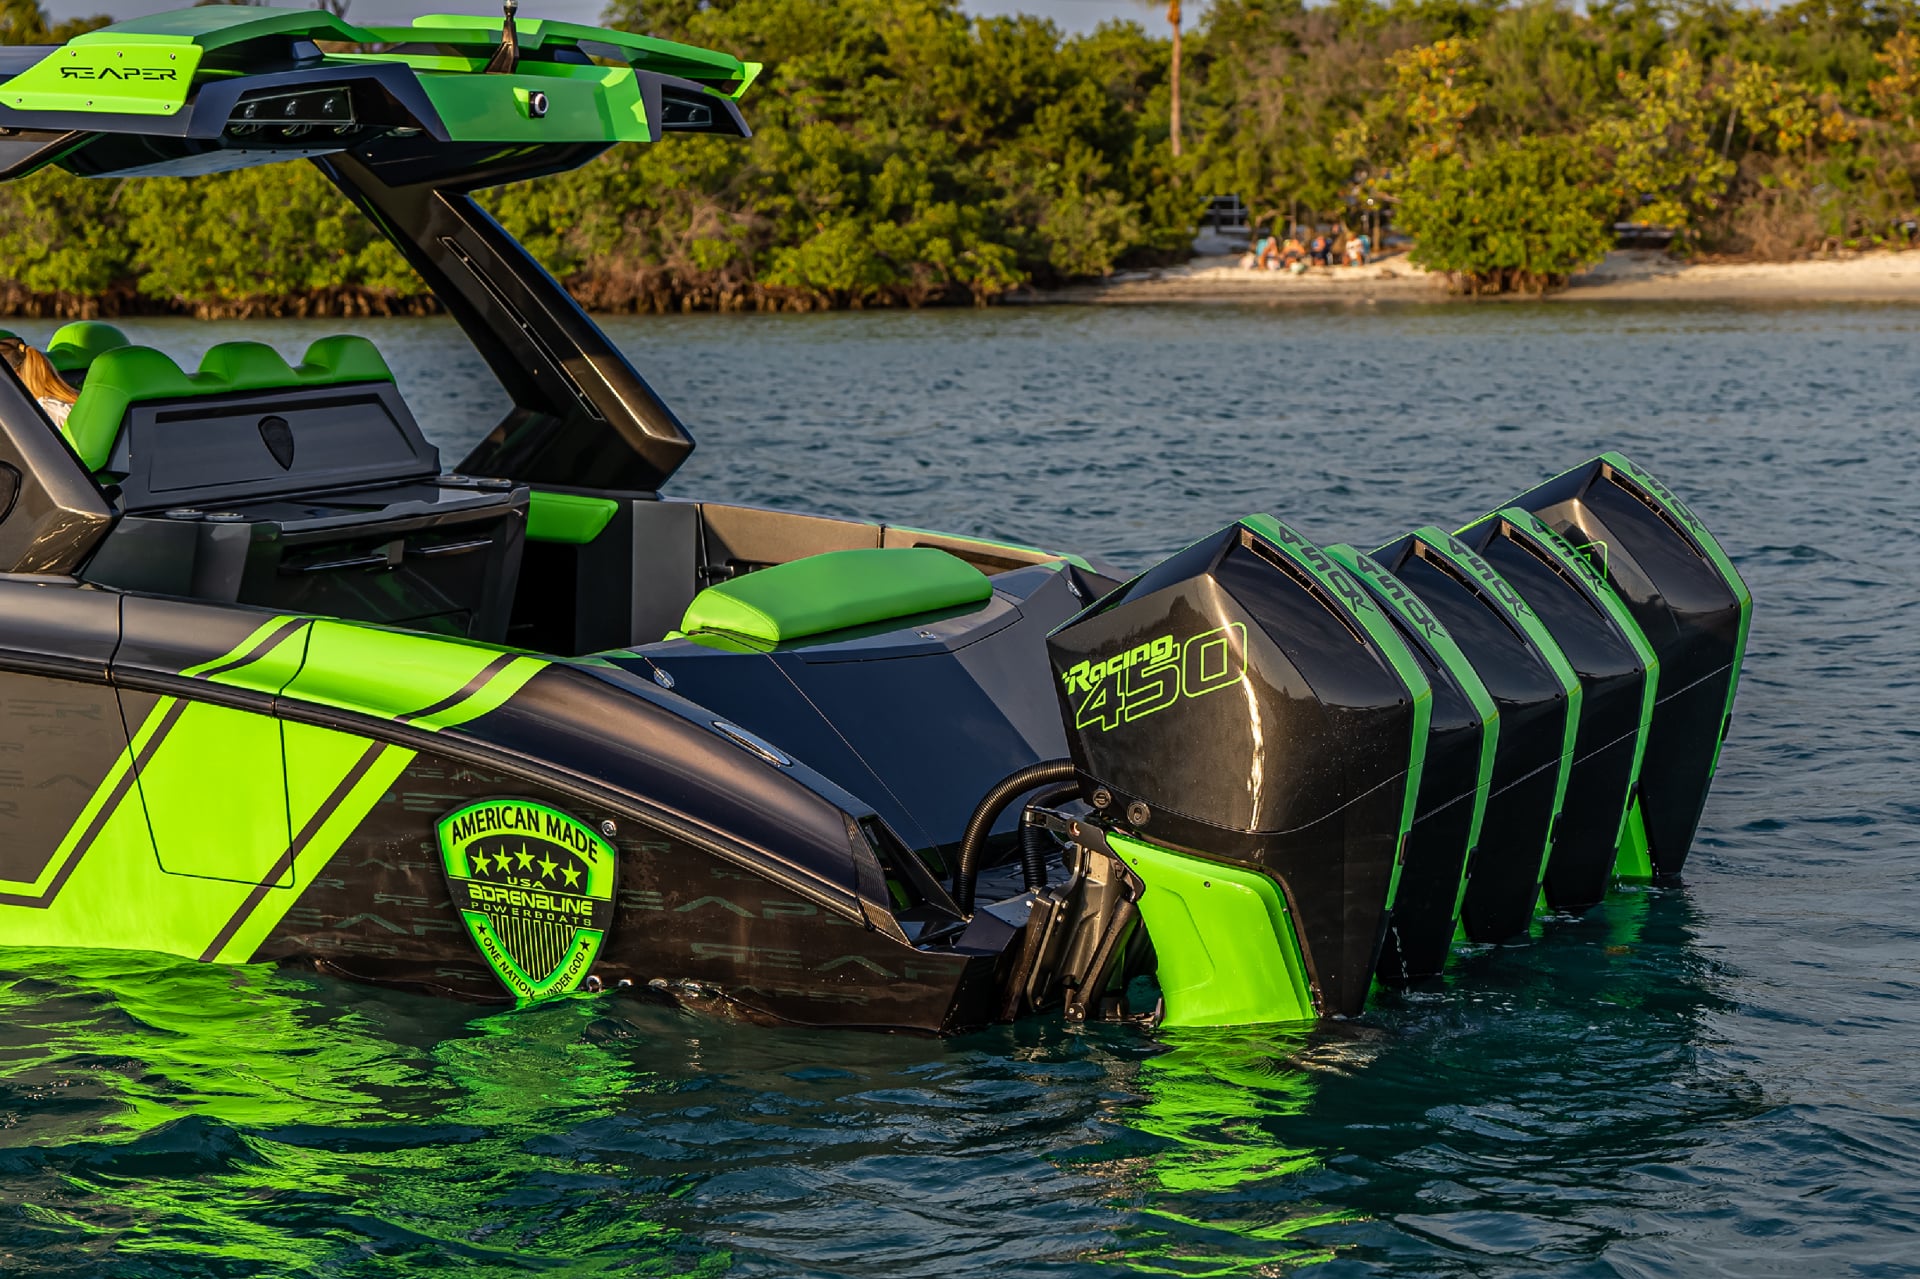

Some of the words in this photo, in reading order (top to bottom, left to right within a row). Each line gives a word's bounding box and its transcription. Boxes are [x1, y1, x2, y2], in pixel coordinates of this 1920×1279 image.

[60, 67, 177, 80] REAPER
[1061, 634, 1174, 695] Racing
[1076, 621, 1248, 732] 450
[452, 805, 540, 845] AMERICAN
[546, 814, 599, 864] MADE
[467, 883, 593, 916] ADRENALINE
[507, 876, 546, 890] USA
[471, 901, 592, 926] POWERBOATS
[483, 937, 503, 962] ONE
[499, 961, 535, 999] NATION
[568, 951, 585, 975] GOD
